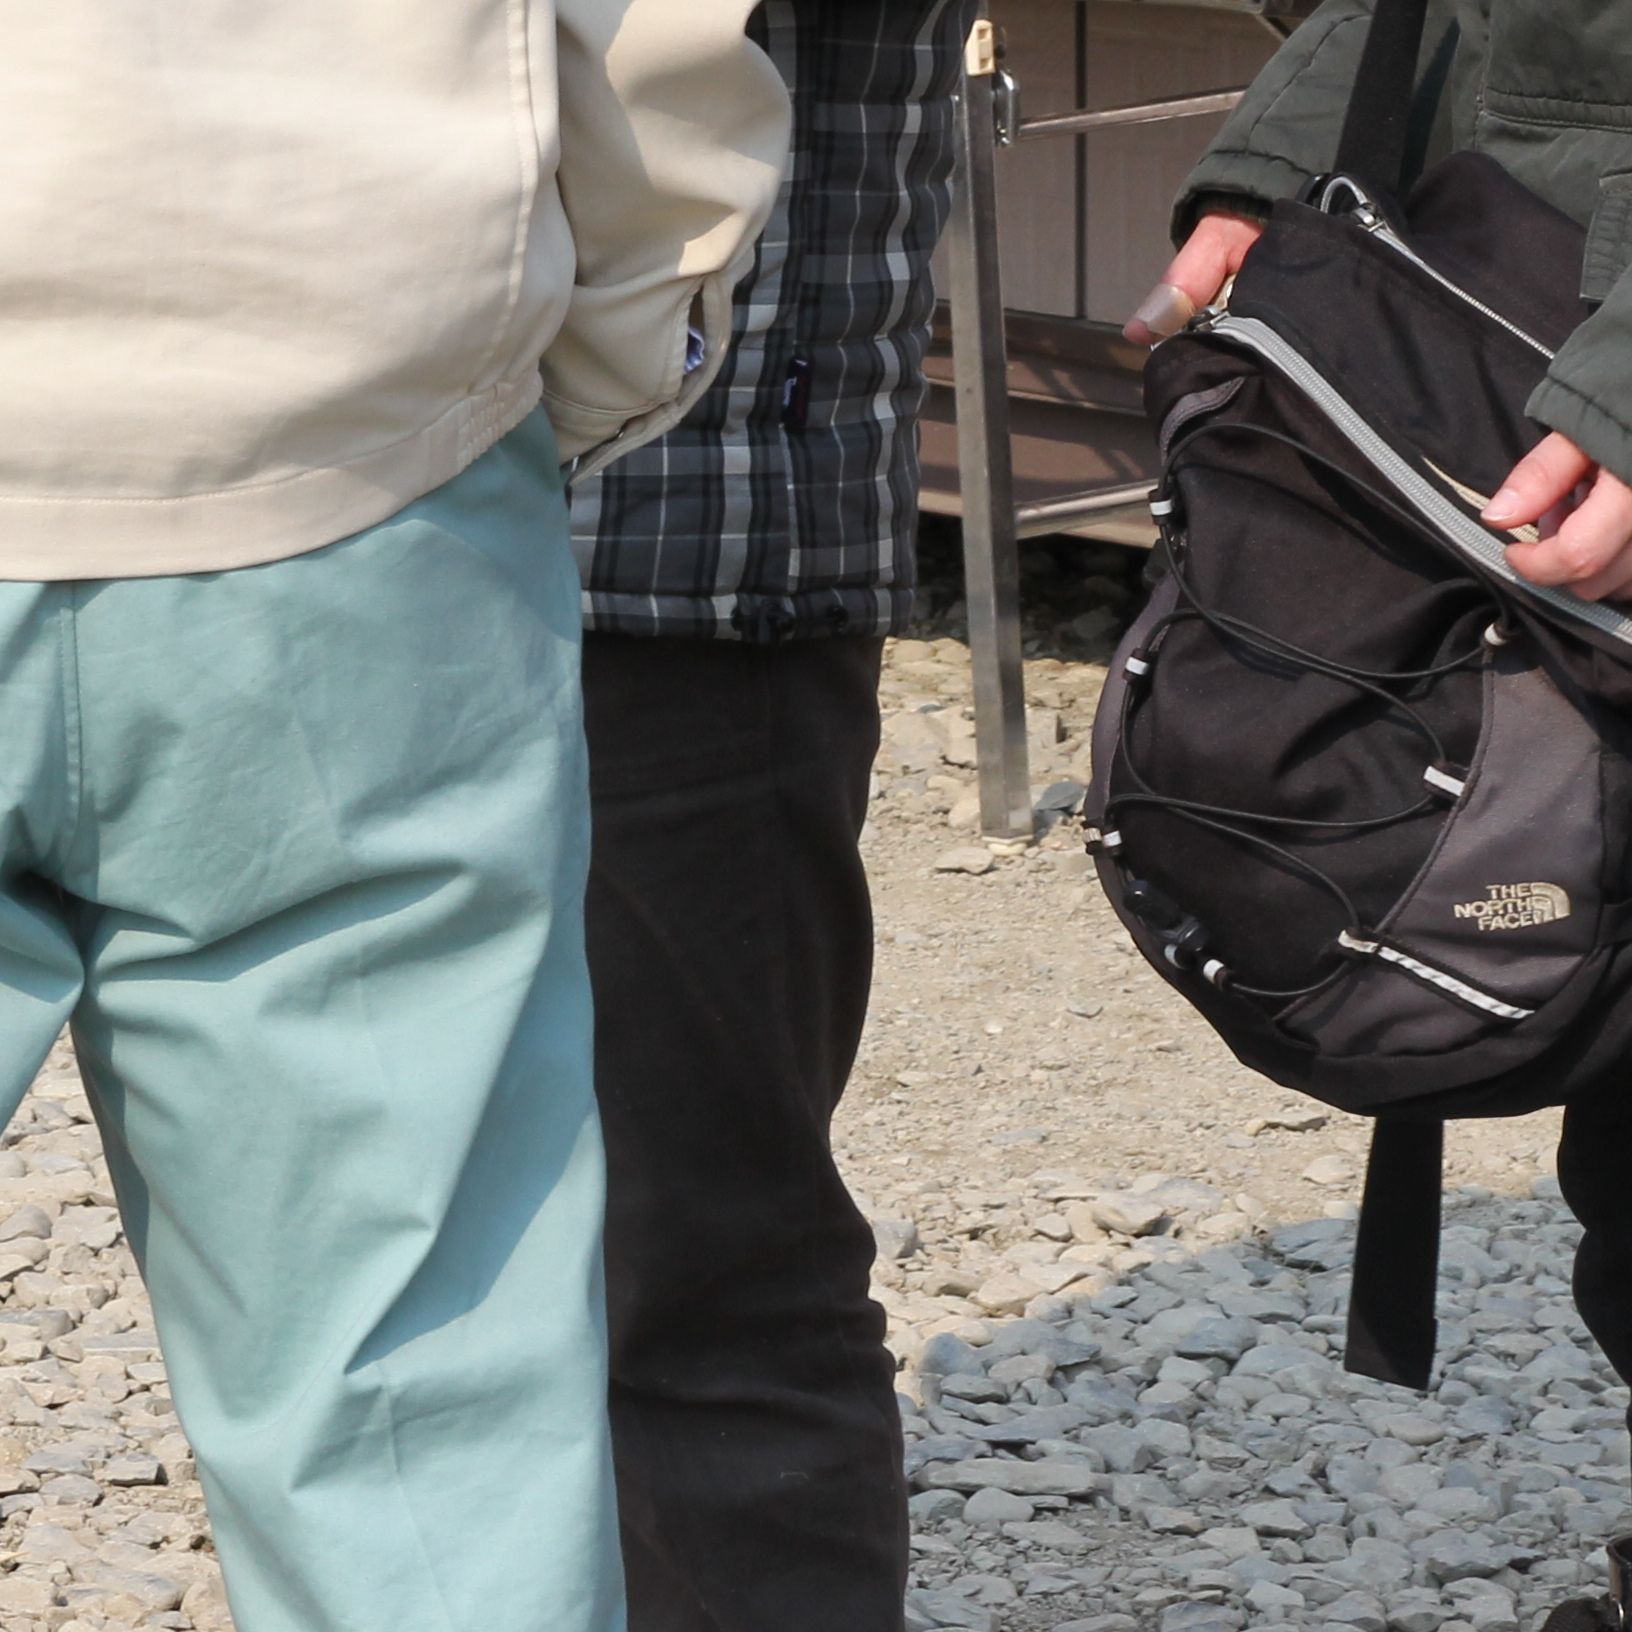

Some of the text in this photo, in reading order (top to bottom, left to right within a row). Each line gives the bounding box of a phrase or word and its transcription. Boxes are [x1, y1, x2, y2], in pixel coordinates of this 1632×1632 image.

[1486, 883, 1533, 901] THE
[1453, 896, 1534, 919] NORTH
[1477, 911, 1534, 932] FACE
